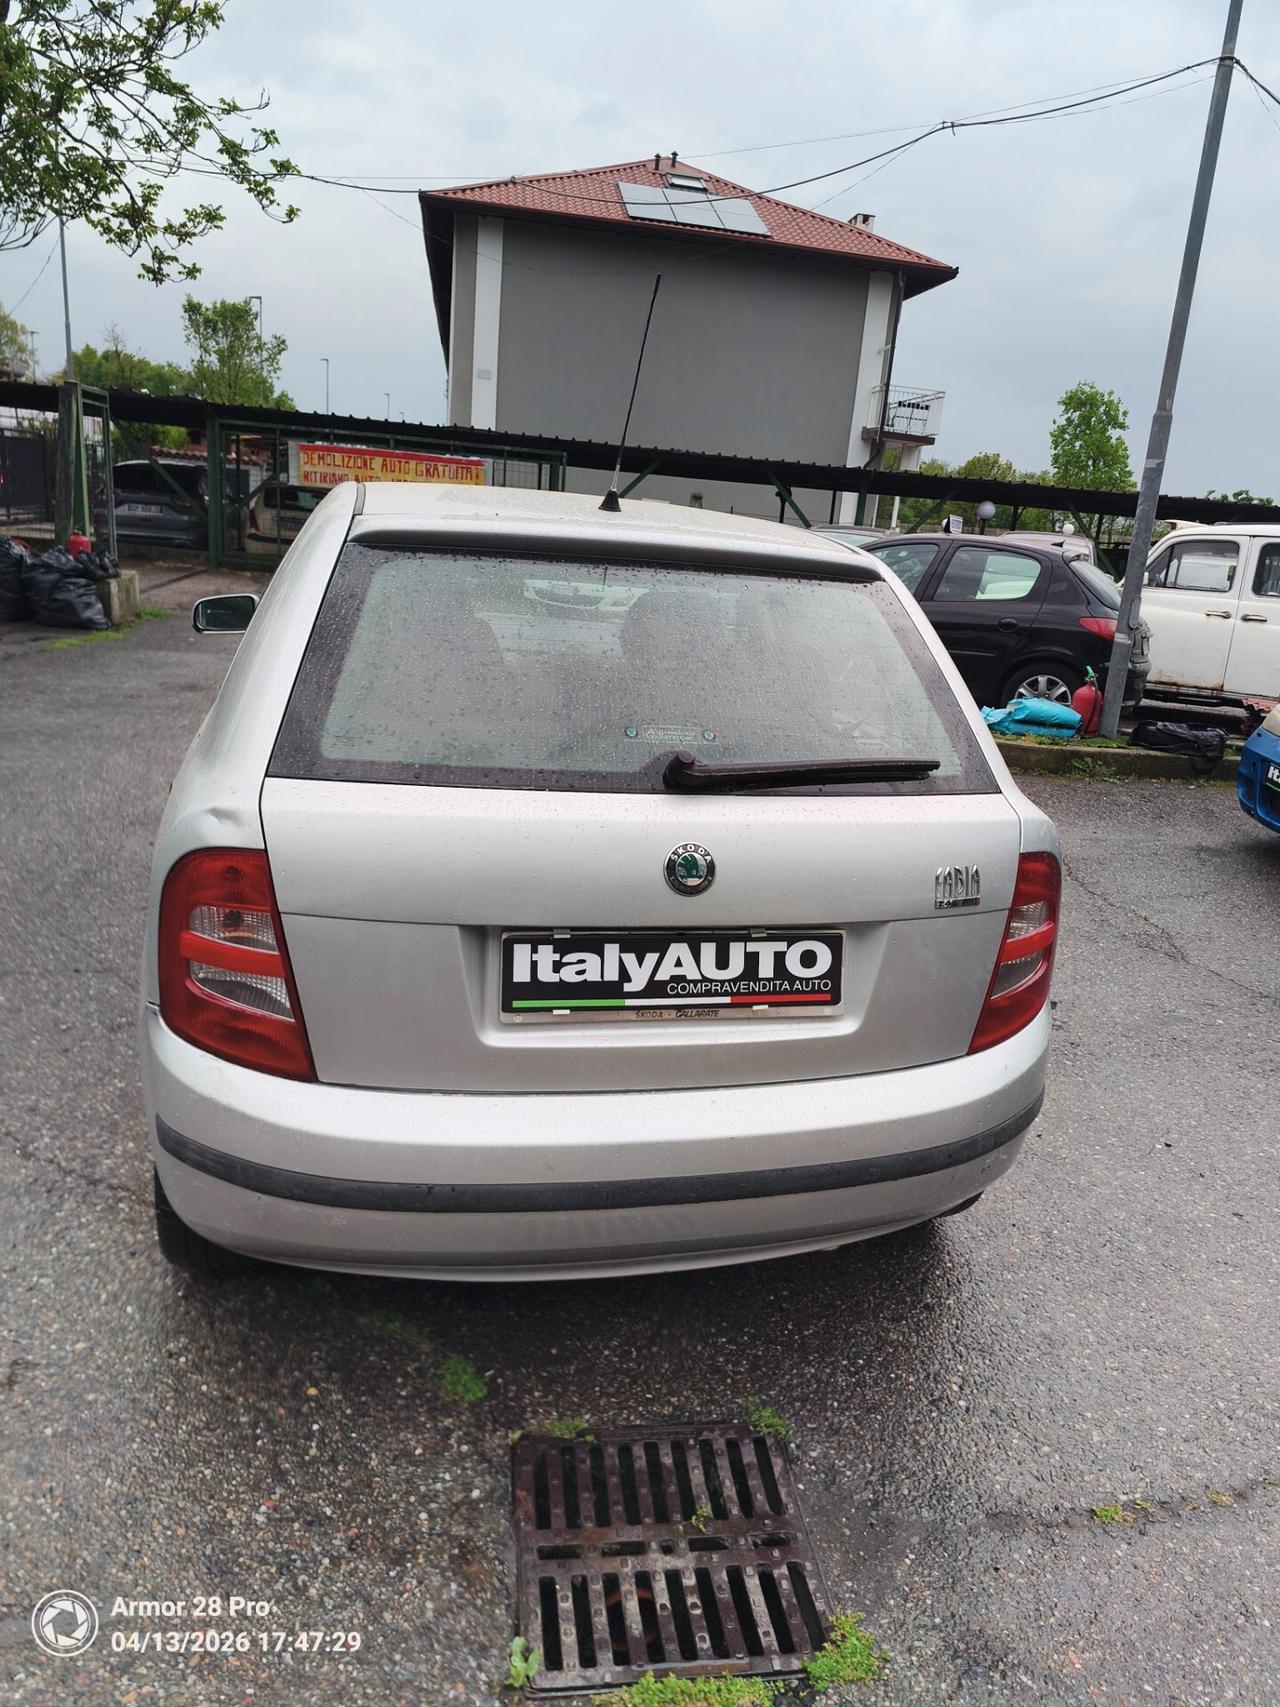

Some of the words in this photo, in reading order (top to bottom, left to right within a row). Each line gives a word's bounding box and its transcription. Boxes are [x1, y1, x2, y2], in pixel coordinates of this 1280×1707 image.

[303, 451, 375, 470] DEMOLIZIONE
[381, 457, 410, 475] AUTO
[935, 864, 980, 900] FABIA
[512, 940, 832, 992] ItalyAUTO
[667, 981, 790, 994] COMPRAVENDITA
[793, 979, 831, 991] AUTO
